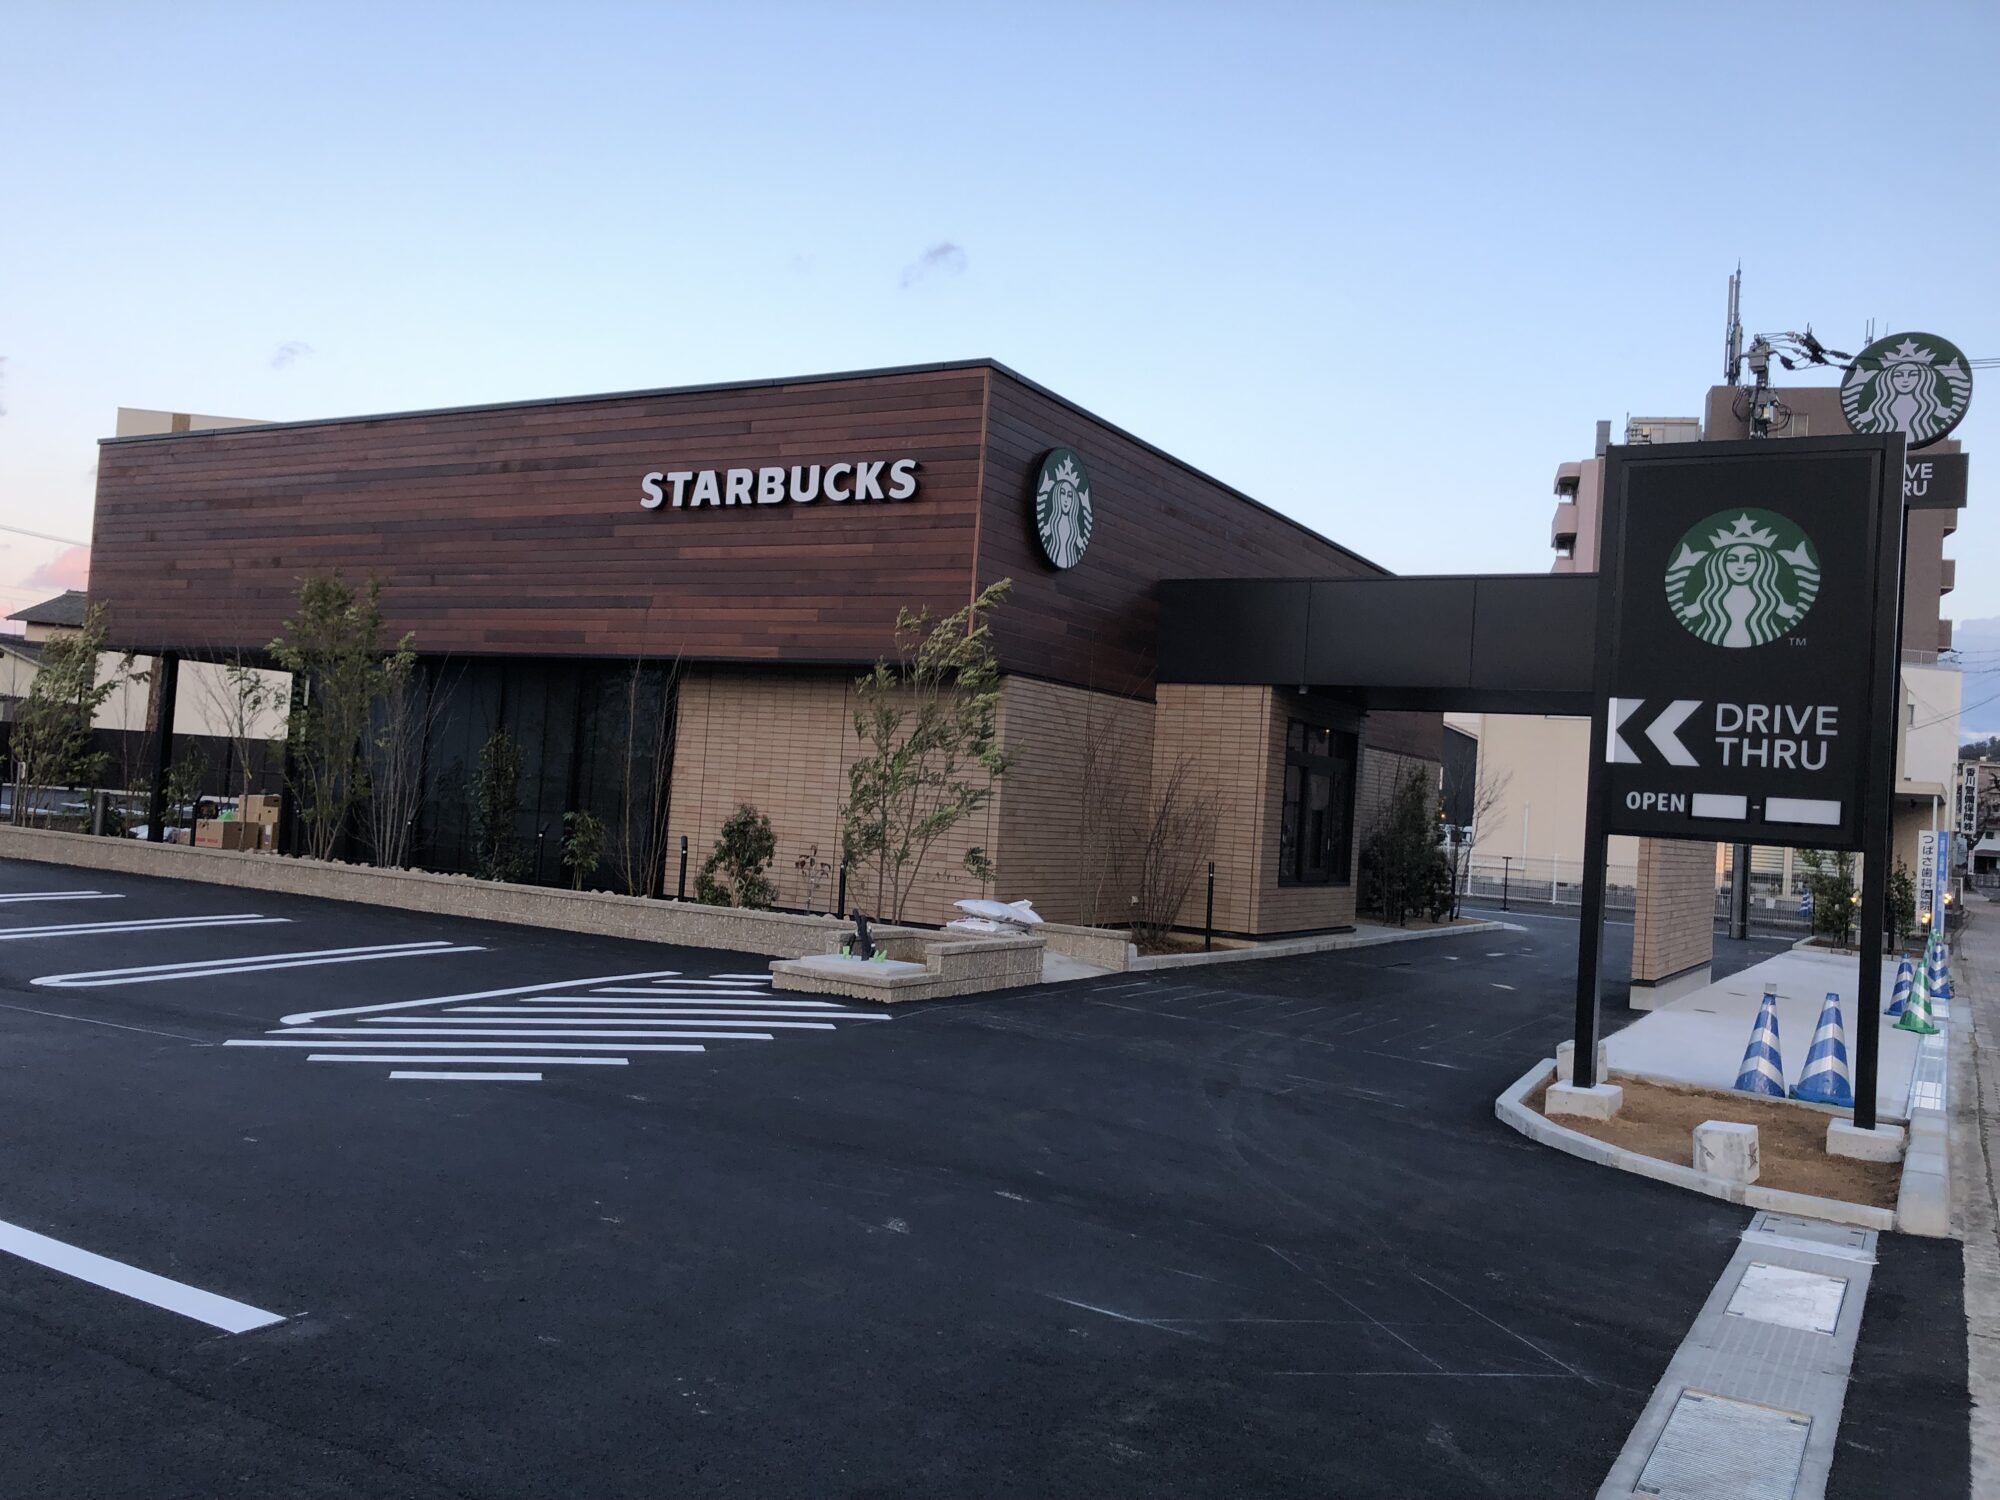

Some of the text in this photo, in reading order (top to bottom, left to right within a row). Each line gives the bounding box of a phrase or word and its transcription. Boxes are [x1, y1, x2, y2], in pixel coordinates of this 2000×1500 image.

[1905, 463, 1933, 479] VE
[639, 459, 919, 509] STARBUCKS
[1904, 481, 1927, 496] RU
[1789, 637, 1807, 646] TM
[1715, 703, 1839, 736] DRIVE
[1715, 737, 1828, 771] THRU
[1626, 791, 1686, 813] OPEN
